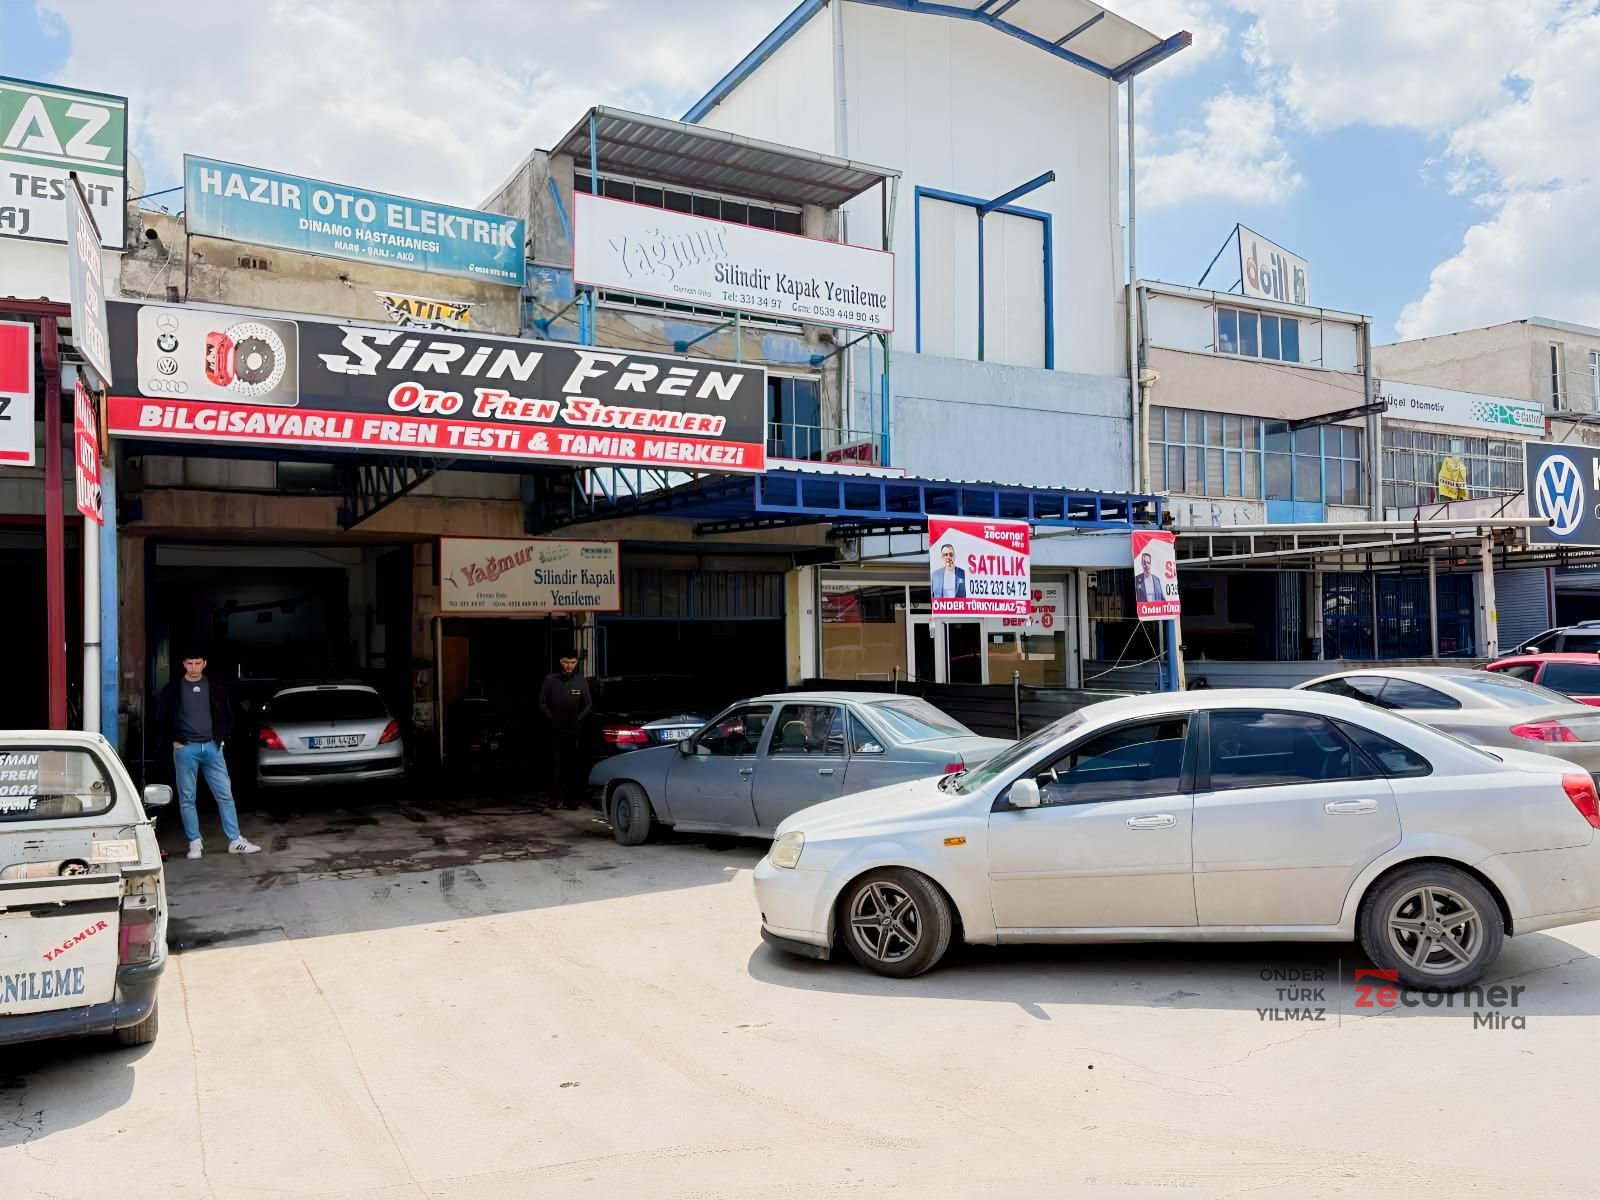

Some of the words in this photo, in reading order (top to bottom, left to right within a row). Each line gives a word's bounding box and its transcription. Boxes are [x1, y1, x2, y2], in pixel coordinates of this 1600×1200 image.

[9, 172, 114, 207] TESİT
[200, 166, 302, 211] HAZIR
[311, 190, 377, 223] OTO
[387, 203, 518, 249] ELEKTRİK
[714, 262, 771, 290] Silindir
[776, 272, 820, 301] Kapak
[824, 280, 887, 309] Yenileme
[561, 350, 745, 401] FREN
[475, 390, 557, 420] FREN
[1410, 398, 1445, 412] Otomotiv
[361, 419, 439, 444] FREN
[447, 425, 521, 450] TESTİ
[527, 431, 550, 452] &
[558, 433, 636, 458] TAMİR
[643, 440, 745, 465] MERKEZİ
[460, 545, 534, 588] Yağmur
[533, 568, 578, 585] Silindir
[580, 568, 616, 588] Kapak
[967, 554, 1026, 577] SATILIK
[550, 589, 601, 606] Yenileme
[969, 579, 989, 595] 0352
[989, 580, 1005, 596] 232
[1006, 580, 1016, 597] 64
[1017, 581, 1028, 597] 72
[932, 599, 965, 611] ÖNDER
[966, 600, 1016, 612] TÜRKYILMAZ
[1, 769, 38, 781] FREN
[43, 920, 109, 962] YAGMUR
[0, 966, 85, 1003] NİLEME
